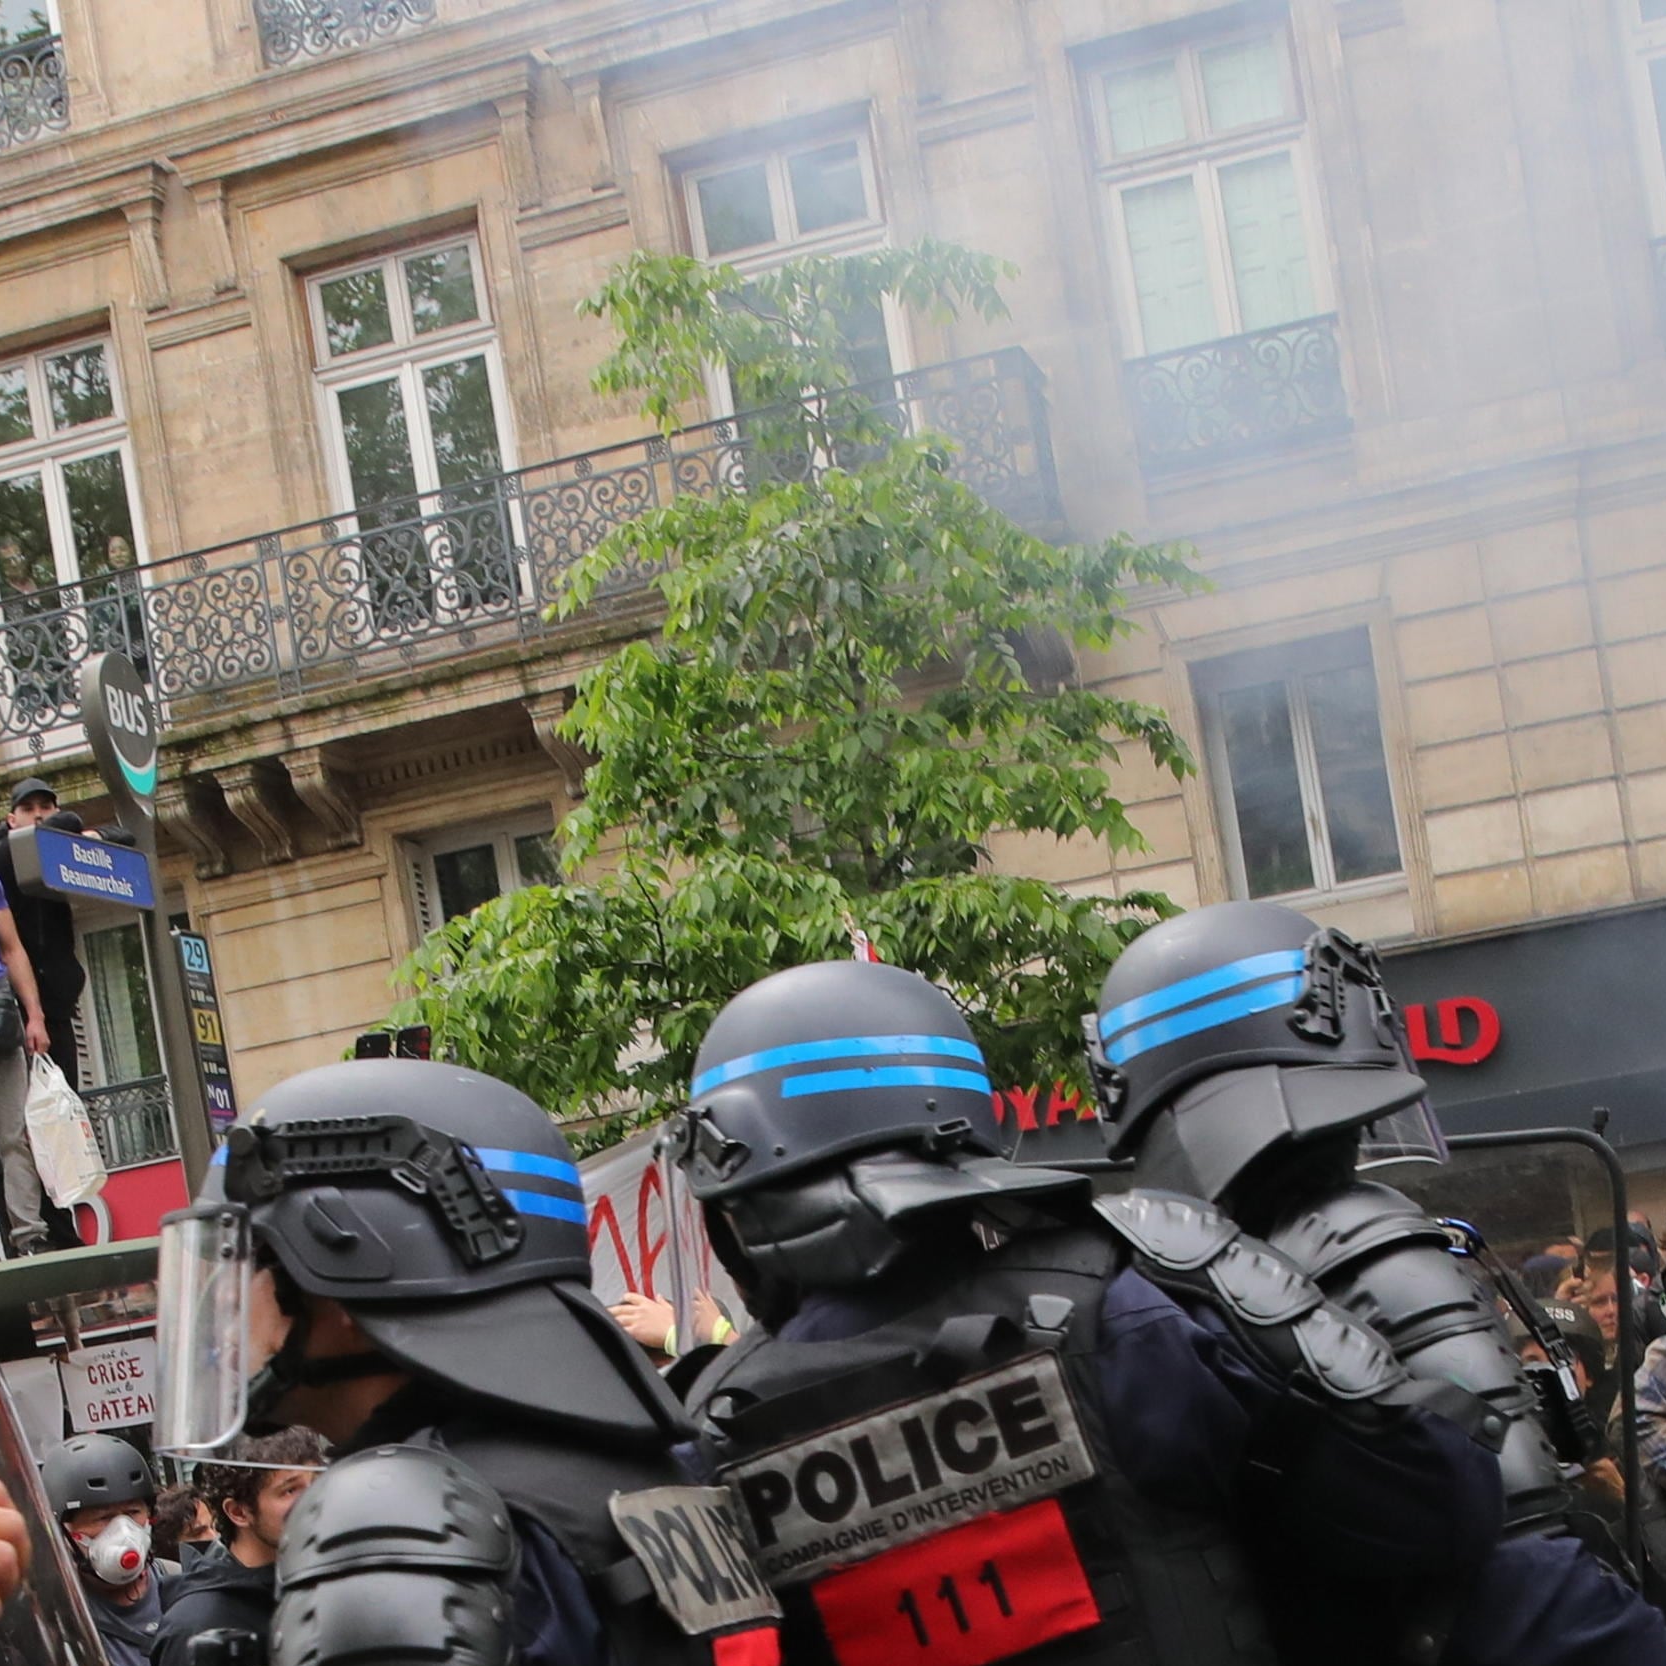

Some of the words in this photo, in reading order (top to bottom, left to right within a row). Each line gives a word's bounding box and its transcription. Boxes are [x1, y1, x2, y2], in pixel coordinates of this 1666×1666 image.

[104, 683, 148, 737] BUS
[71, 842, 113, 871] Bastille
[59, 863, 134, 898] Beaumarchais
[183, 940, 205, 969] 29
[197, 1012, 218, 1041] 91
[737, 1375, 1061, 1548] POLICE
[764, 1519, 888, 1575] COMPAGNIE
[894, 1454, 1071, 1531] D'INTERVENTION
[895, 1559, 1014, 1649] 111
